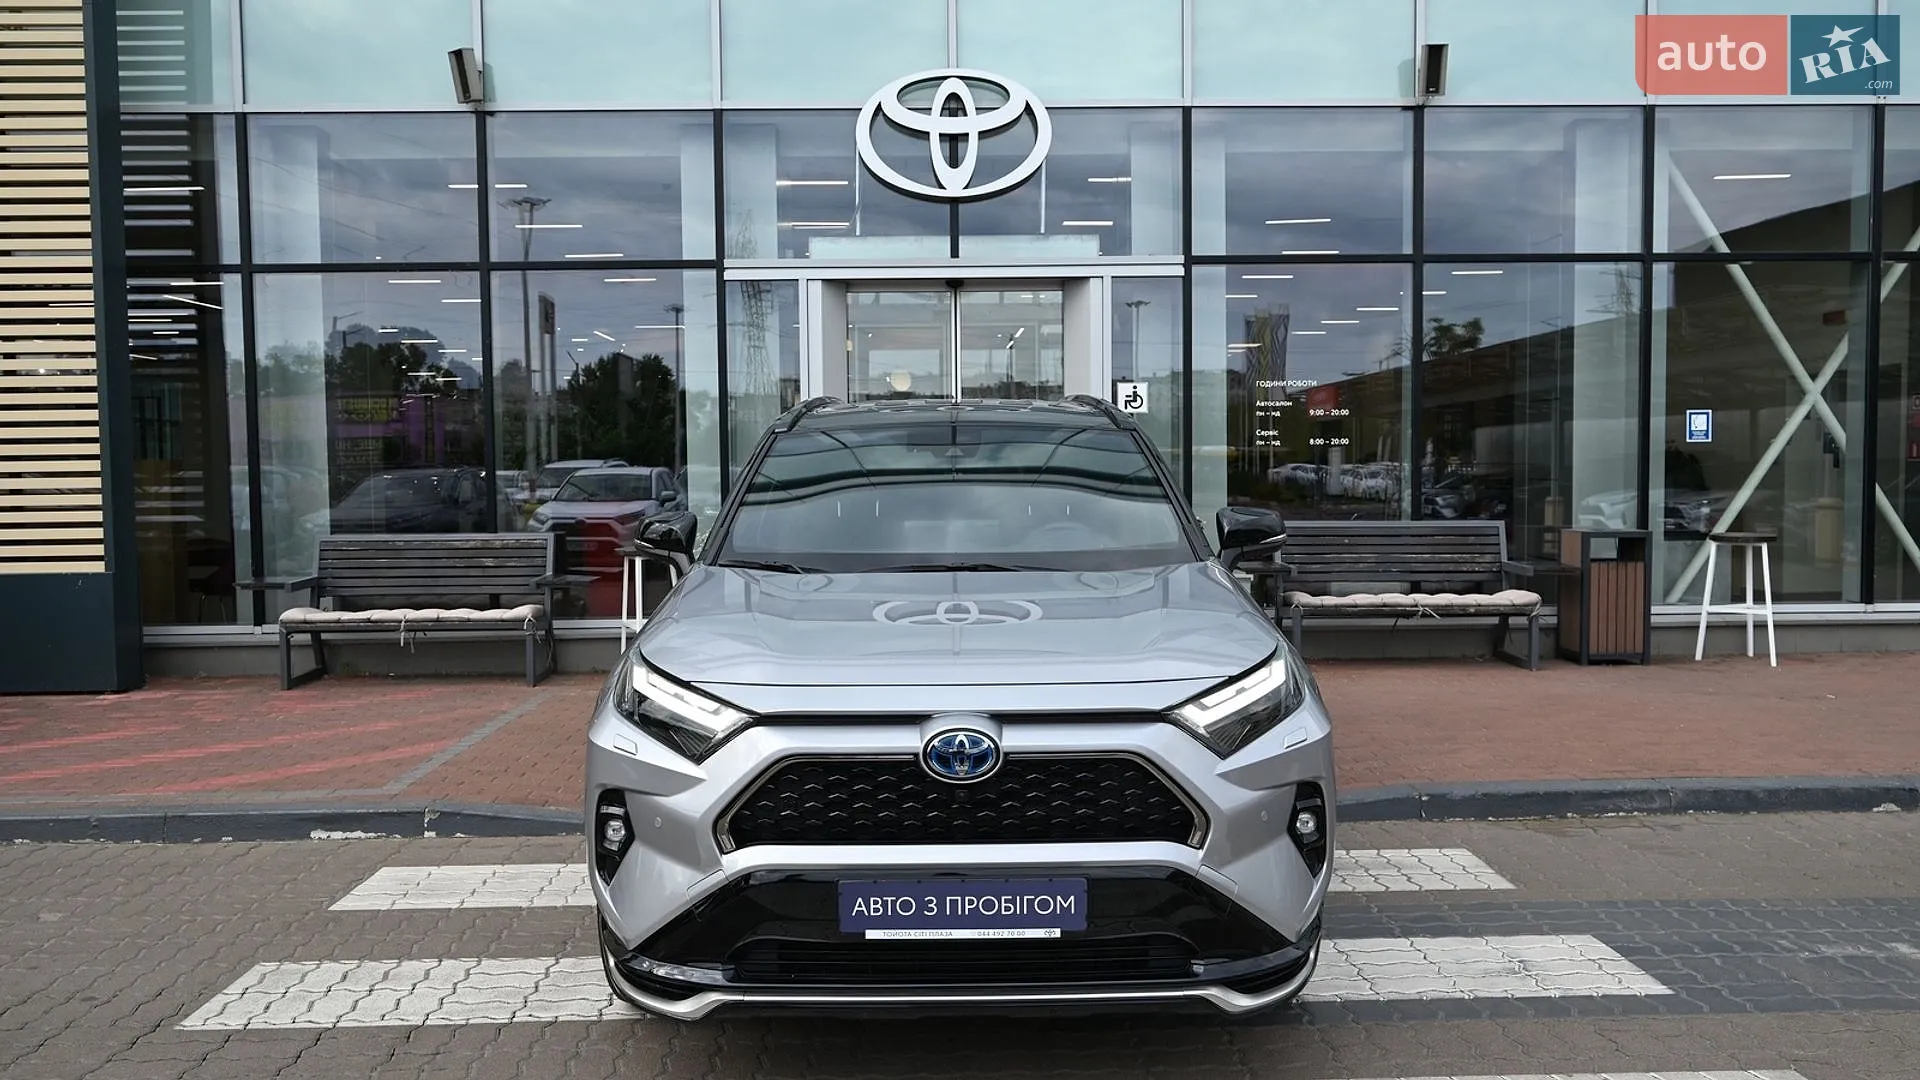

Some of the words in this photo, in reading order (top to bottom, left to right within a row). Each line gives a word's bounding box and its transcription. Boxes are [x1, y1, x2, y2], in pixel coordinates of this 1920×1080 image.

[1256, 380, 1287, 388] ГОДИНИ
[1287, 380, 1318, 388] РОБОТИ
[1255, 429, 1279, 437] Сервіс
[852, 897, 916, 916] АВТО
[946, 895, 1076, 915] ПРОБІГОМ
